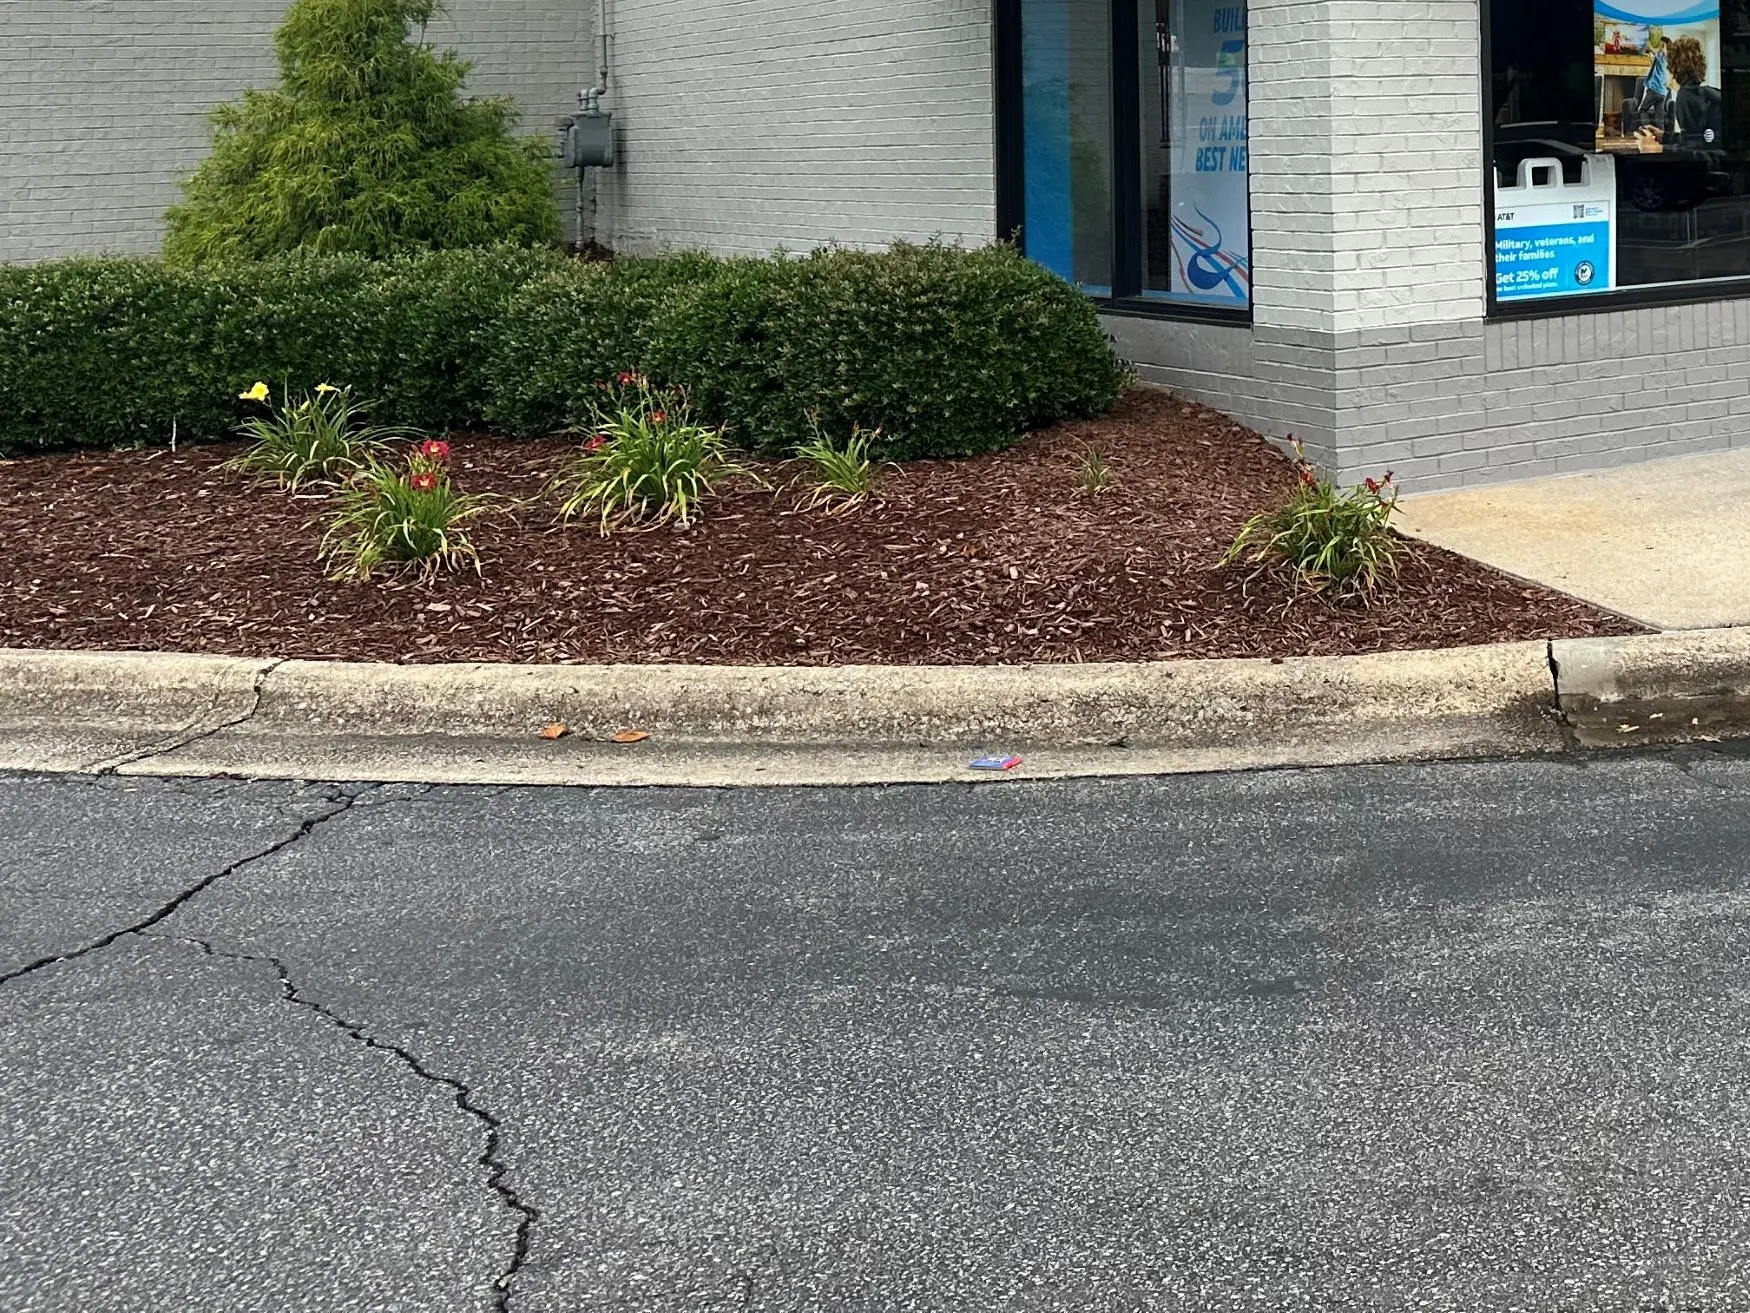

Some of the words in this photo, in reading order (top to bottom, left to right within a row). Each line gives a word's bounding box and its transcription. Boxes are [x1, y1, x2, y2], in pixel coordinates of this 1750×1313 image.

[1195, 146, 1227, 172] BEST
[1497, 212, 1515, 221] AT&T
[1495, 239, 1533, 251] Military,
[1534, 236, 1577, 248] veterans,
[1577, 233, 1595, 244] and
[1495, 251, 1517, 263] their
[1518, 249, 1556, 261] families
[1496, 272, 1515, 284] Get
[1516, 269, 1540, 283] 25%
[1541, 266, 1560, 280] off
